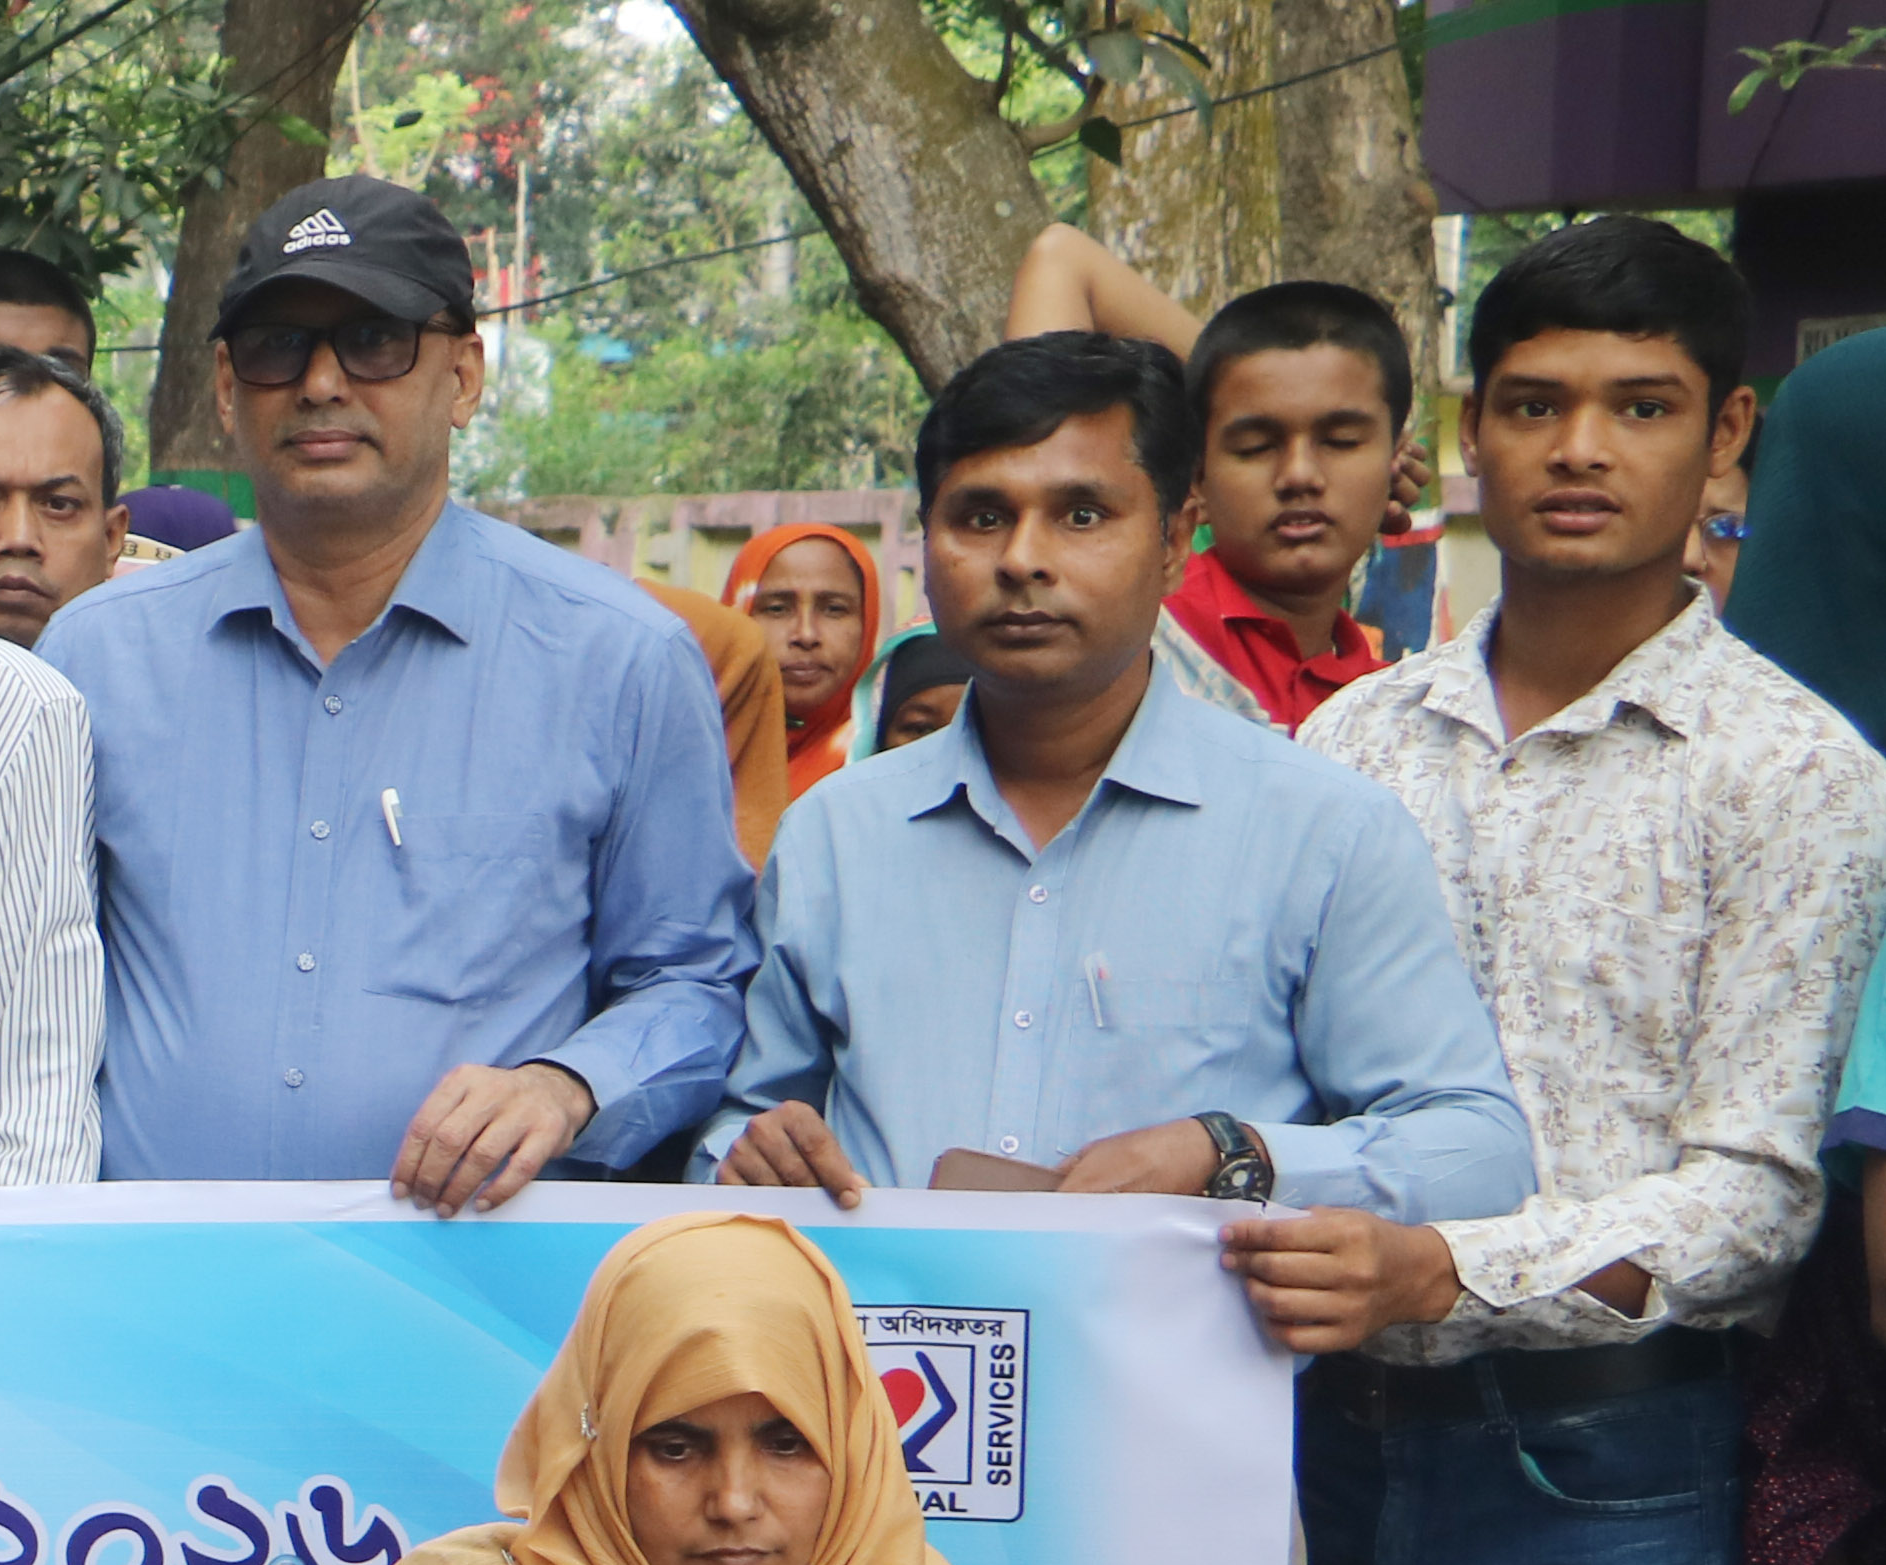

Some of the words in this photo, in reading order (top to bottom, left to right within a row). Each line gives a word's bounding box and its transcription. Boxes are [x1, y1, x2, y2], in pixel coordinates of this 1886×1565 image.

[283, 233, 351, 254] adidas
[878, 1309, 1008, 1339] অধিদফতর
[986, 1343, 1016, 1486] SERVICES
